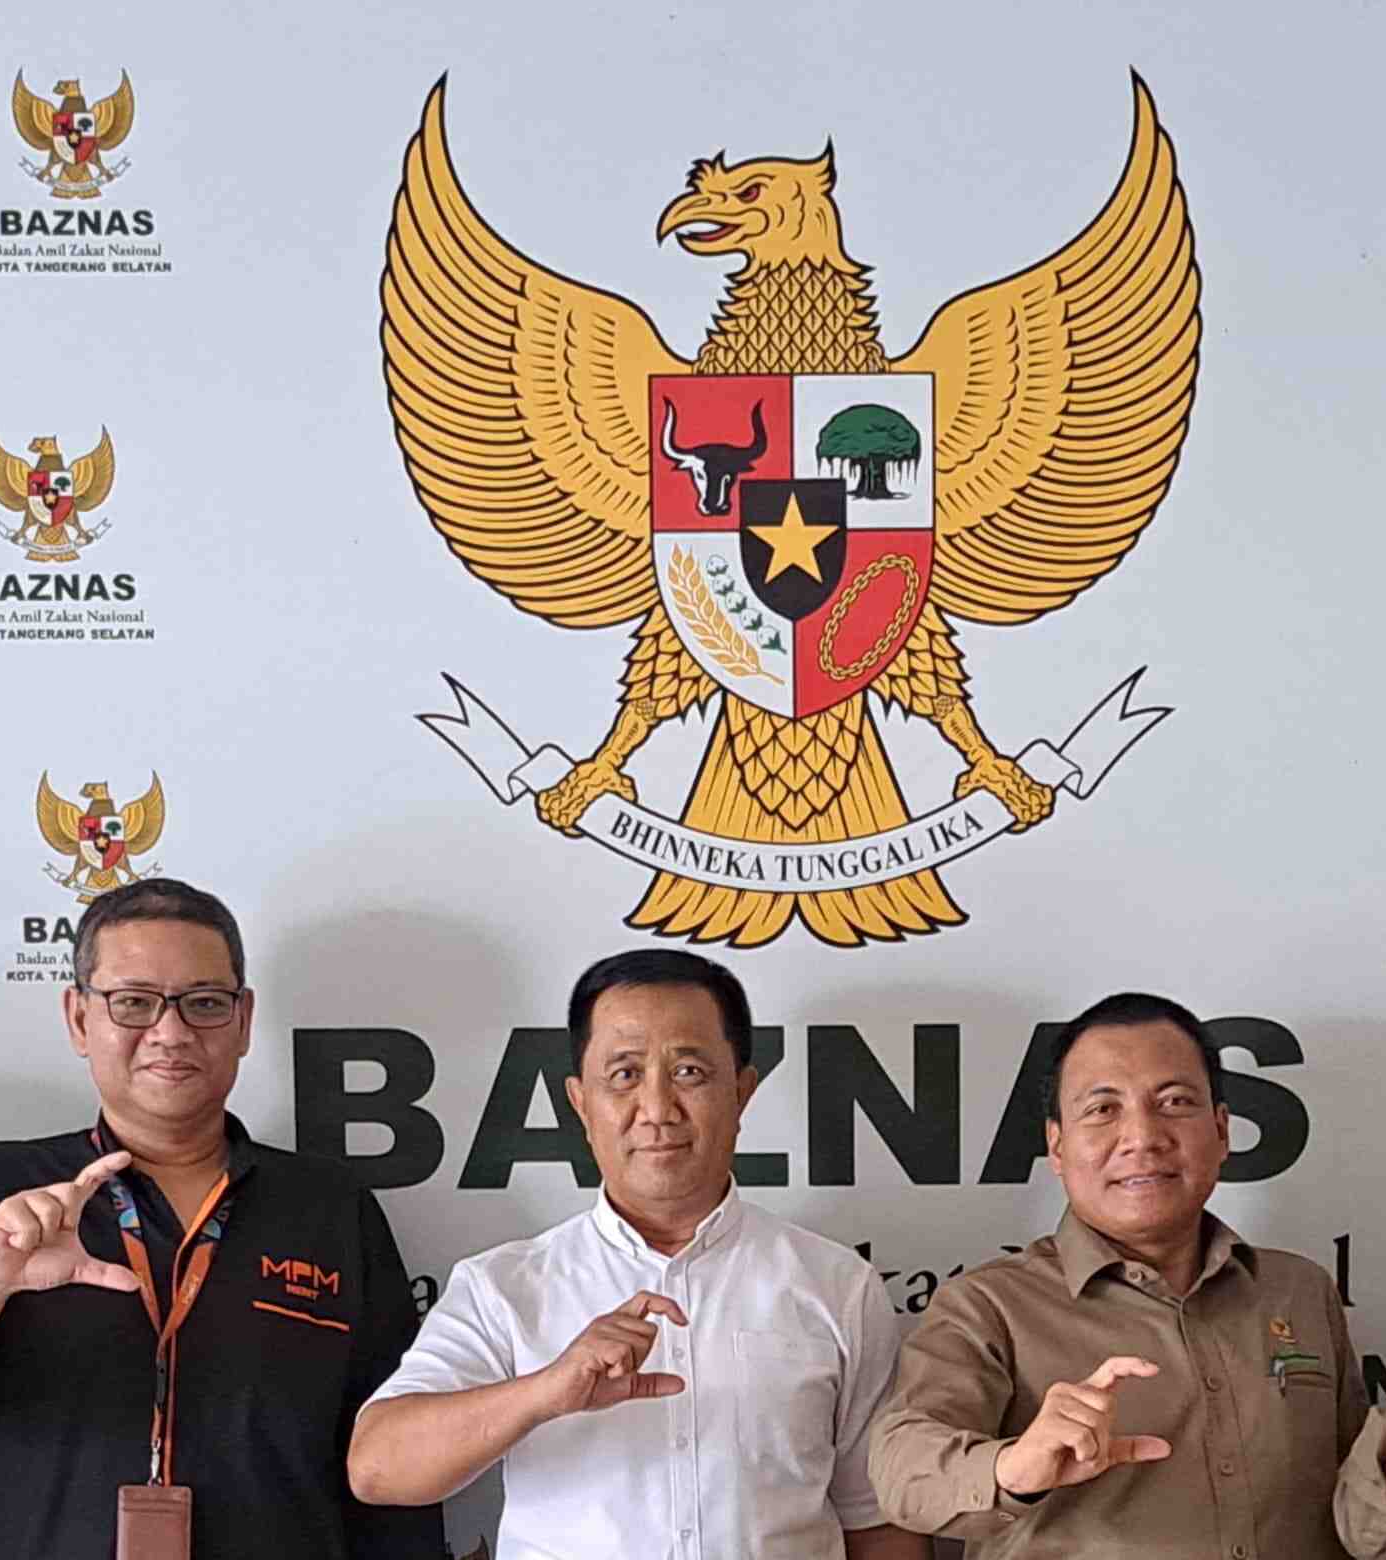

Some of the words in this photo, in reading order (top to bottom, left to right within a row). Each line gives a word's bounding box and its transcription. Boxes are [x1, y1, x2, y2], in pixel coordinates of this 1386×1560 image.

[610, 809, 765, 881] BHINNEKA
[774, 835, 924, 882] TUNGGAL
[926, 810, 984, 855] IKA
